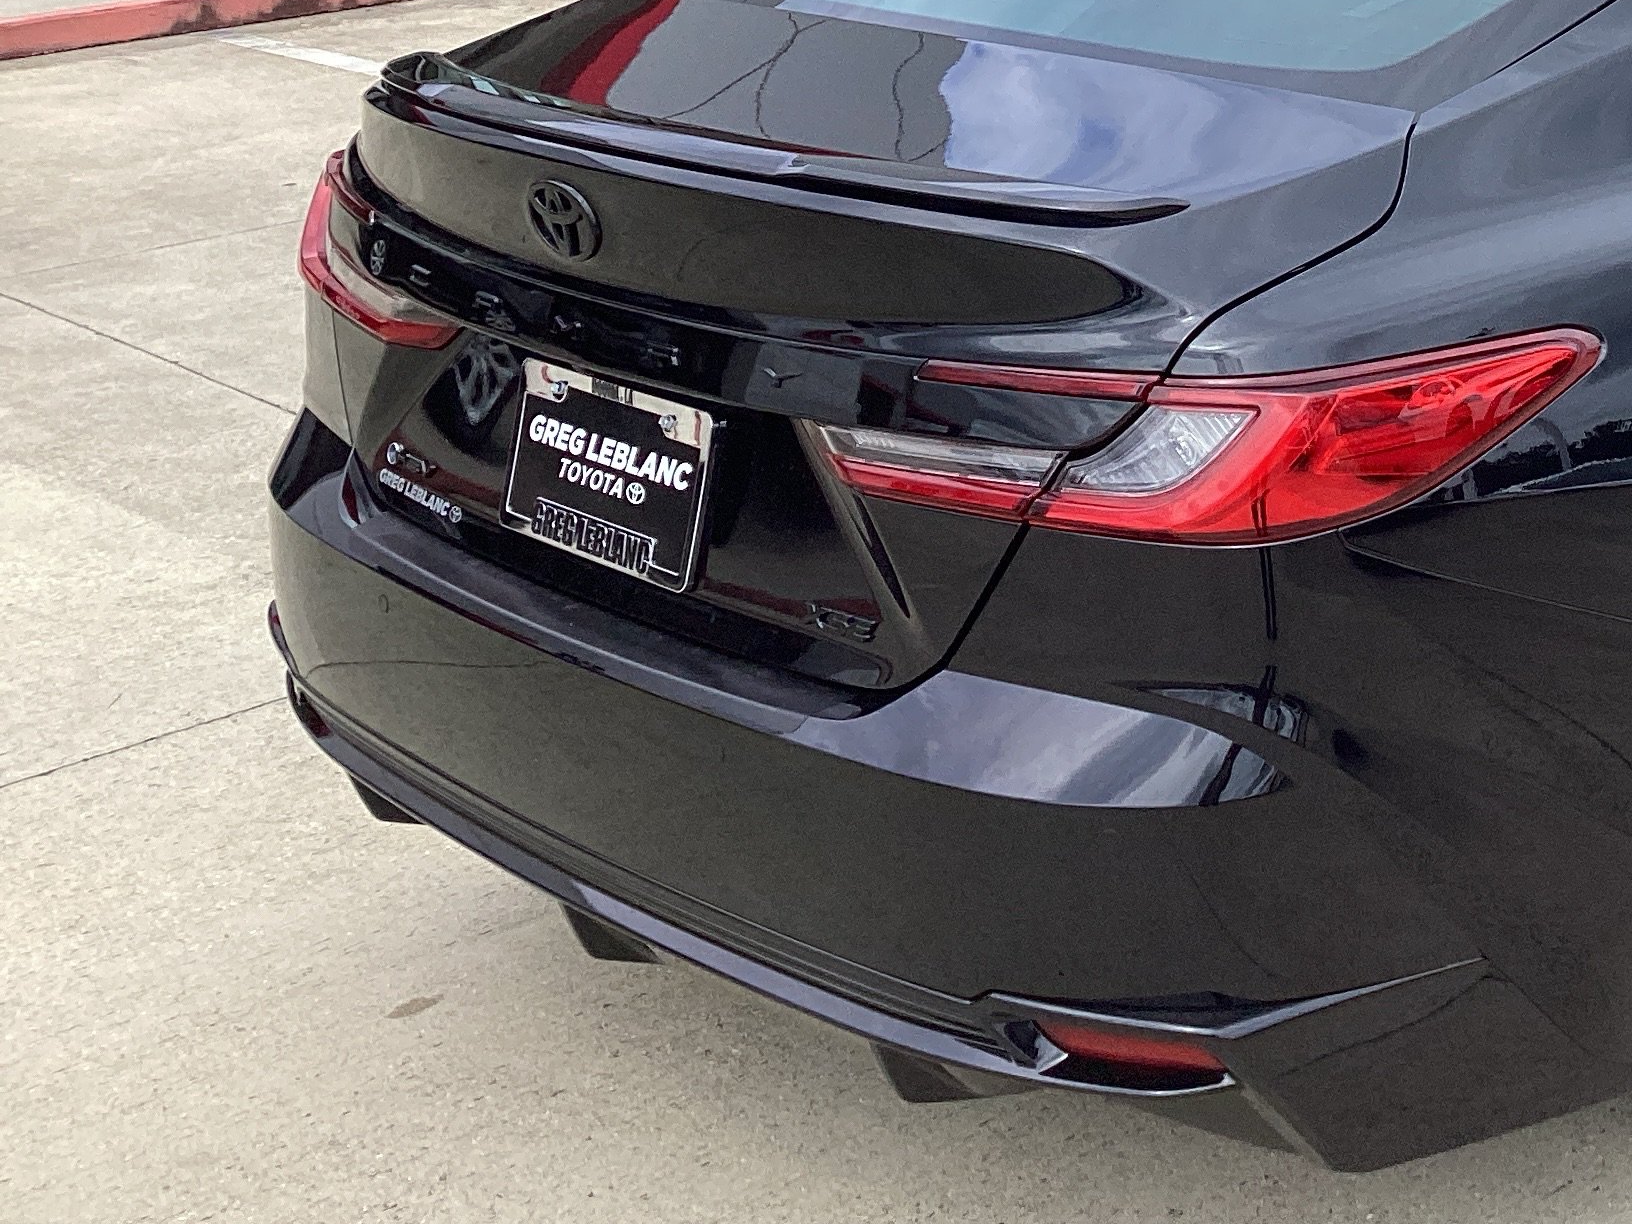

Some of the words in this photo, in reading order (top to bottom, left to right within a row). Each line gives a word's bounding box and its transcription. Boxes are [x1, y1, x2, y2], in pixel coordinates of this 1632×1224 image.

[529, 414, 585, 456] GREG
[585, 433, 693, 491] LEBLANC
[558, 457, 625, 499] TOYOTA
[380, 468, 405, 492] GREG
[404, 481, 450, 516] LEBLANC
[531, 500, 578, 547] GREG
[577, 516, 655, 574] LEBLANC
